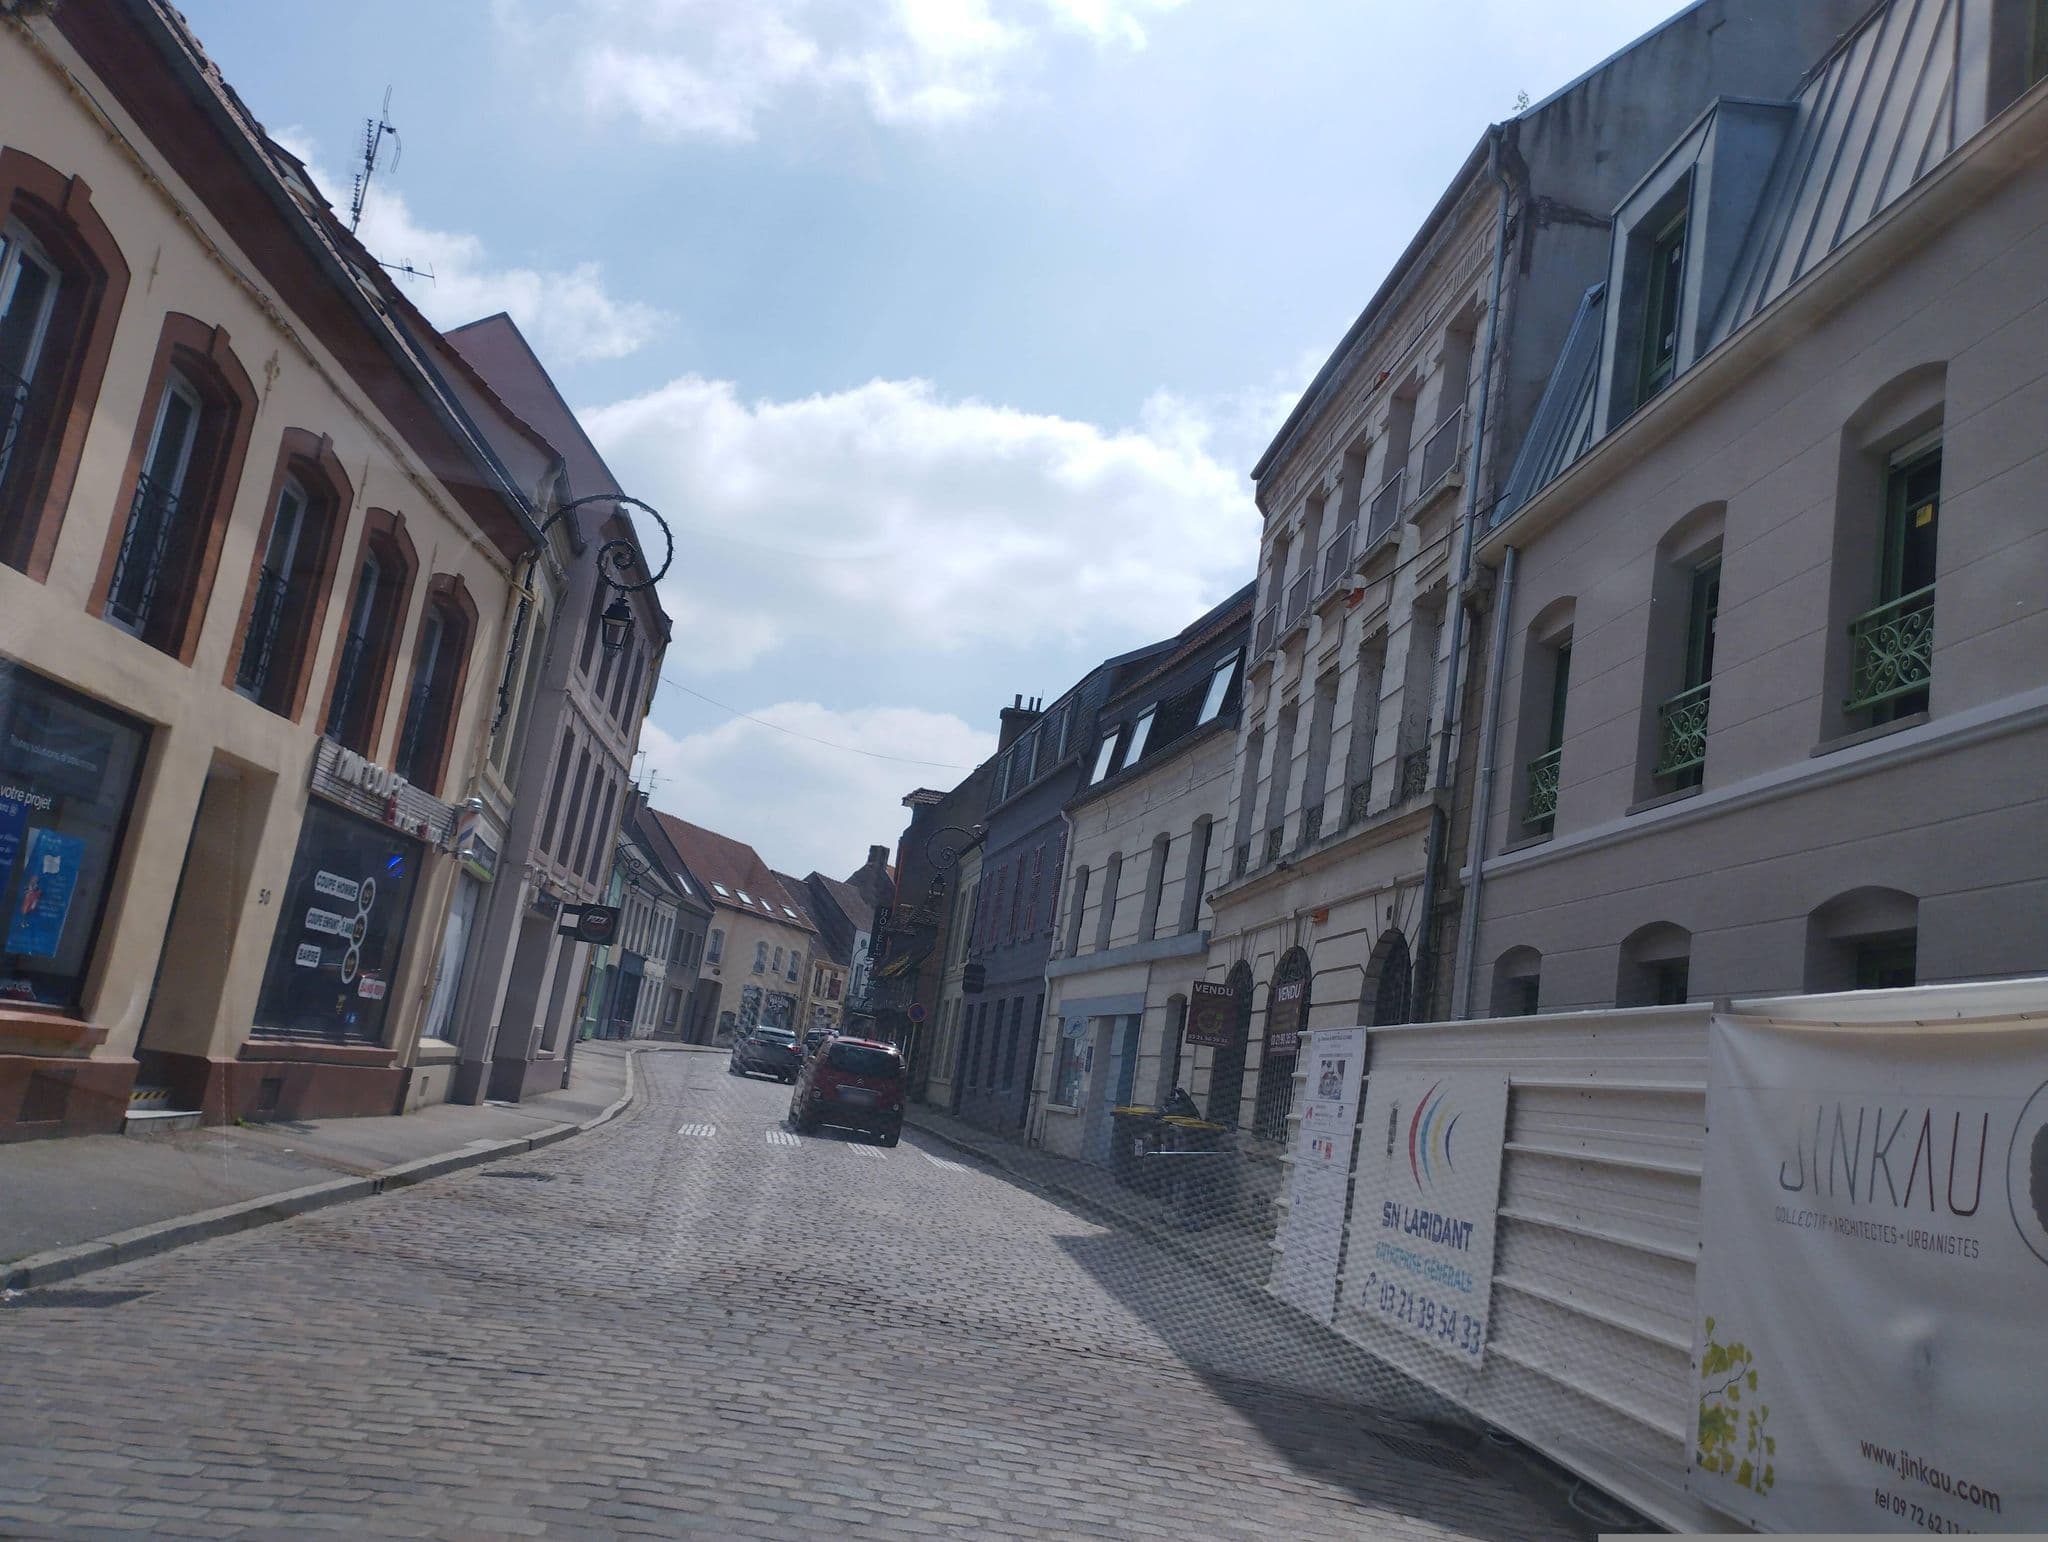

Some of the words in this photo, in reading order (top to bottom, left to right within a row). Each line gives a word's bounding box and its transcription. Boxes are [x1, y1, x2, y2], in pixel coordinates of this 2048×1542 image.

[0, 785, 24, 802] votre
[24, 793, 52, 810] projet
[317, 875, 337, 891] COUPE
[1195, 983, 1234, 997] VENDU
[1278, 983, 1302, 1002] VENDU
[1779, 1101, 1990, 1217] JINKAU
[1382, 1201, 1401, 1231] SN
[1403, 1207, 1474, 1252] LARIDANT
[1775, 1206, 1828, 1229] COLLECTIF
[1833, 1216, 1897, 1245] ARCHITECTES
[1906, 1230, 1980, 1260] URBANISTES
[1379, 1281, 1396, 1313] 03
[1398, 1288, 1414, 1323] 21
[1418, 1297, 1435, 1333] 39
[1438, 1306, 1457, 1345] 54
[1461, 1315, 1481, 1354] 33
[1860, 1440, 2002, 1514] www.jinkau.com
[1875, 1488, 1890, 1511] tel
[1892, 1497, 1907, 1517] 09
[1910, 1504, 1925, 1527] 72
[1928, 1513, 1943, 1534] 62
